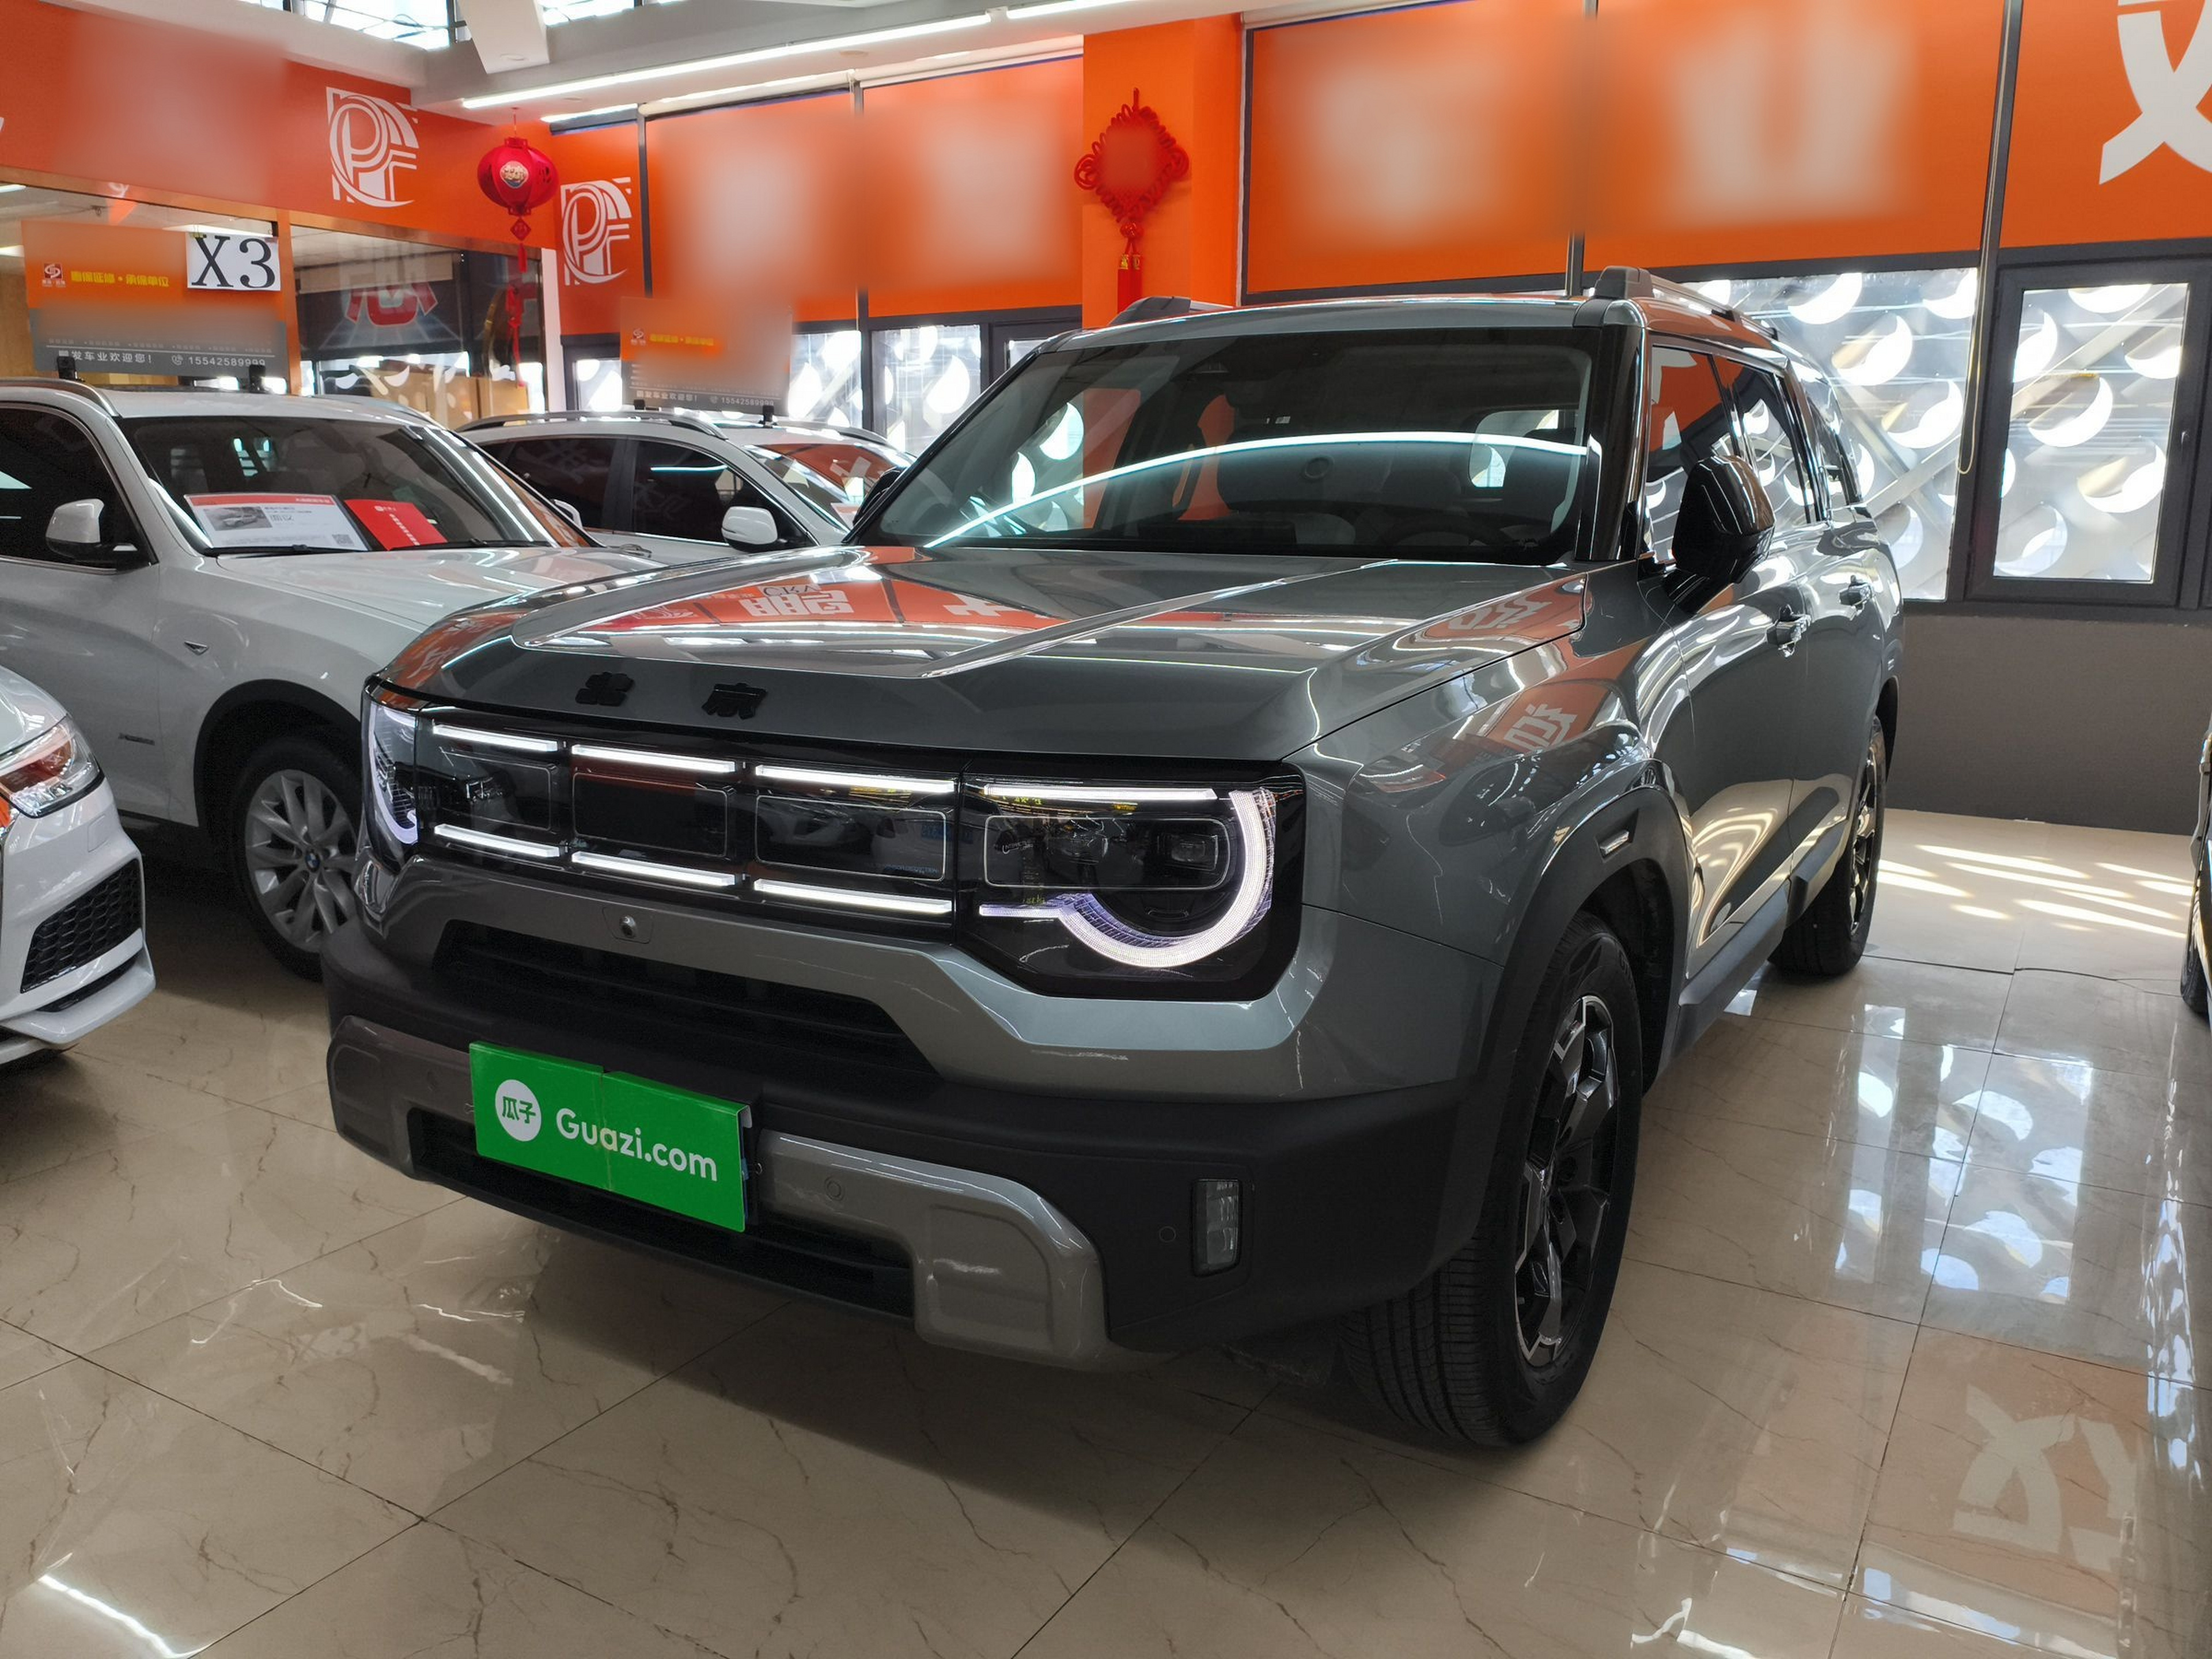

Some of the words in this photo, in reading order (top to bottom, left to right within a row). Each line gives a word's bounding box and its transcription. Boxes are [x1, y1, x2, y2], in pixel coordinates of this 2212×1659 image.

[191, 234, 275, 288] X3
[188, 356, 266, 367] 15542589999
[502, 1096, 536, 1124] 瓜子
[556, 1108, 718, 1182] Guazi.com
